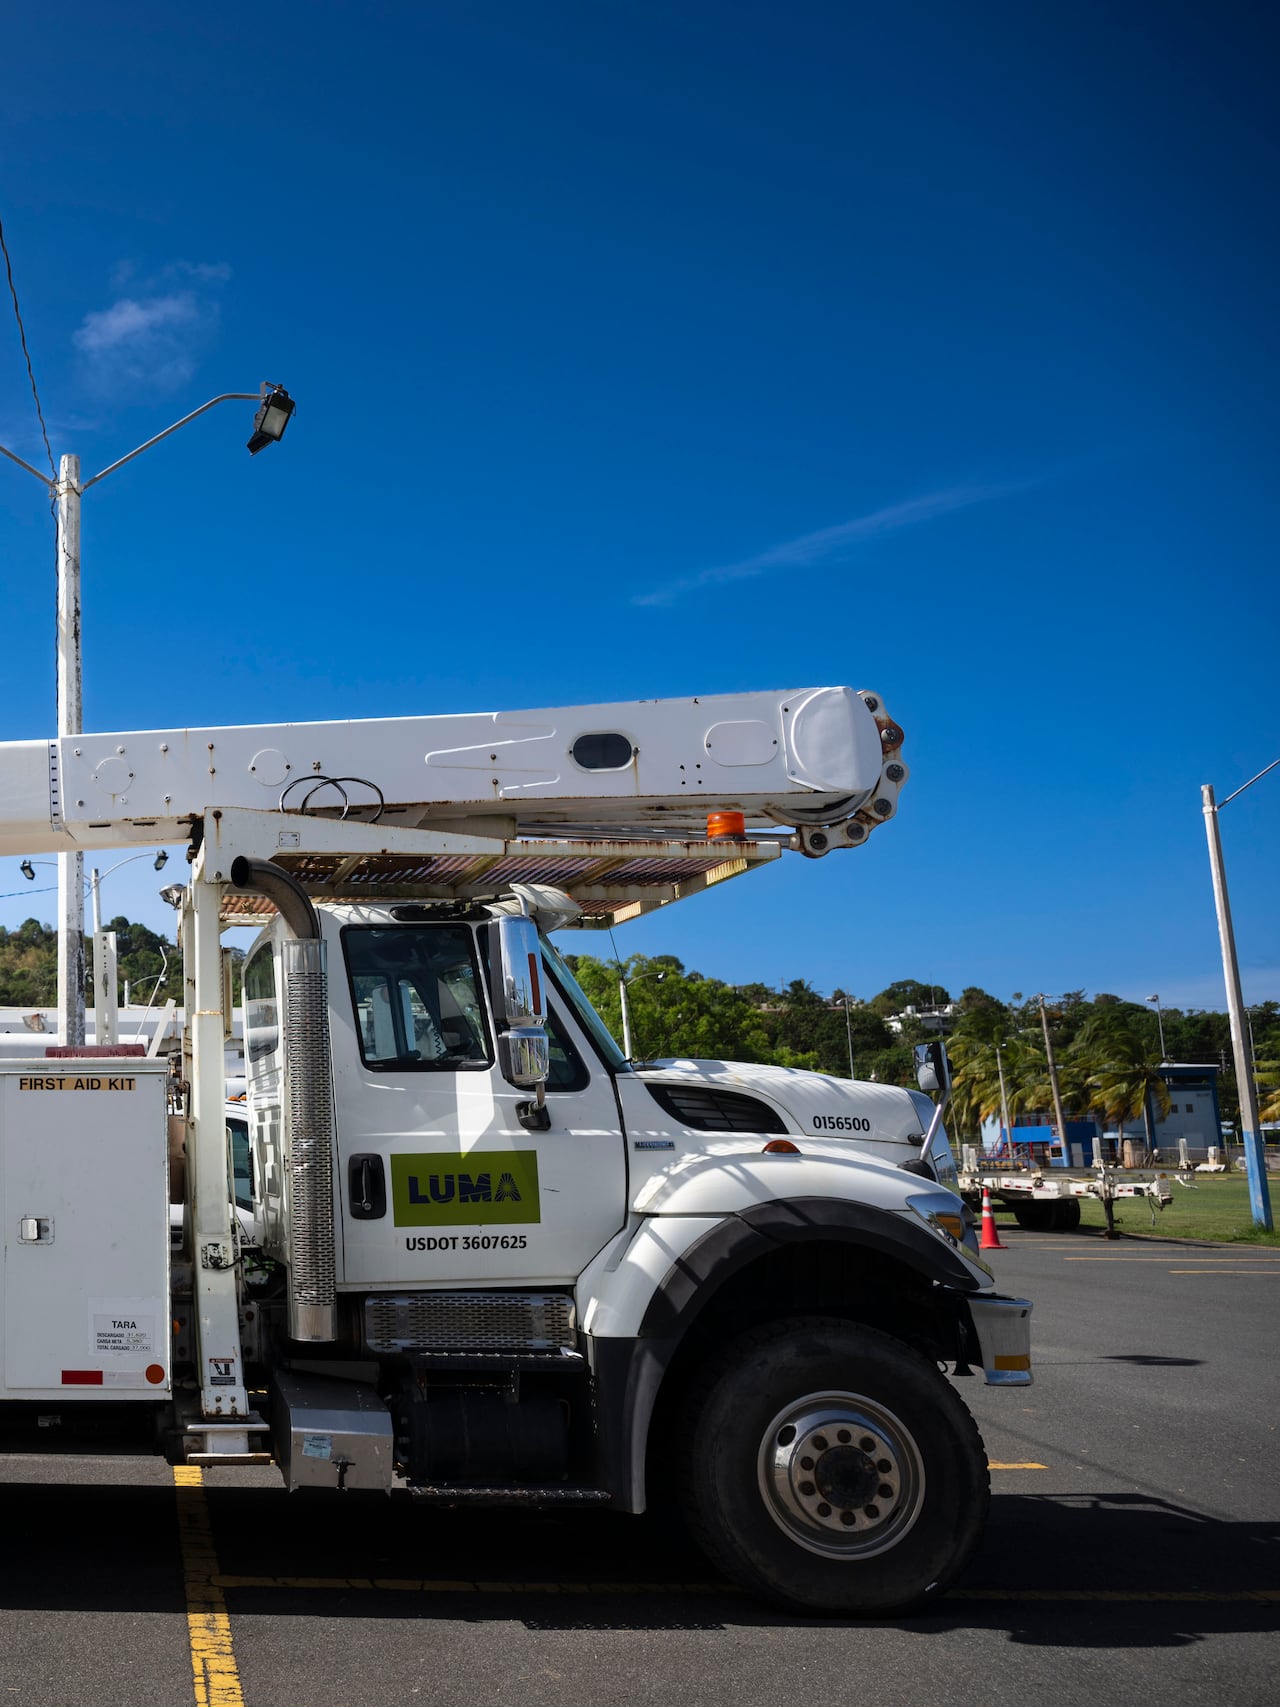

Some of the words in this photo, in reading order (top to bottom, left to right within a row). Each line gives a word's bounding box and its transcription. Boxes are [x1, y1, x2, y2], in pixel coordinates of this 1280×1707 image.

[19, 1078, 66, 1090] FIRST
[74, 1078, 101, 1090] AID
[108, 1078, 136, 1090] KIT
[812, 1115, 870, 1132] 0156500
[408, 1172, 522, 1205] LUMA
[406, 1236, 459, 1251] USDOT
[462, 1235, 527, 1250] 3607625
[112, 1320, 137, 1329] TARA
